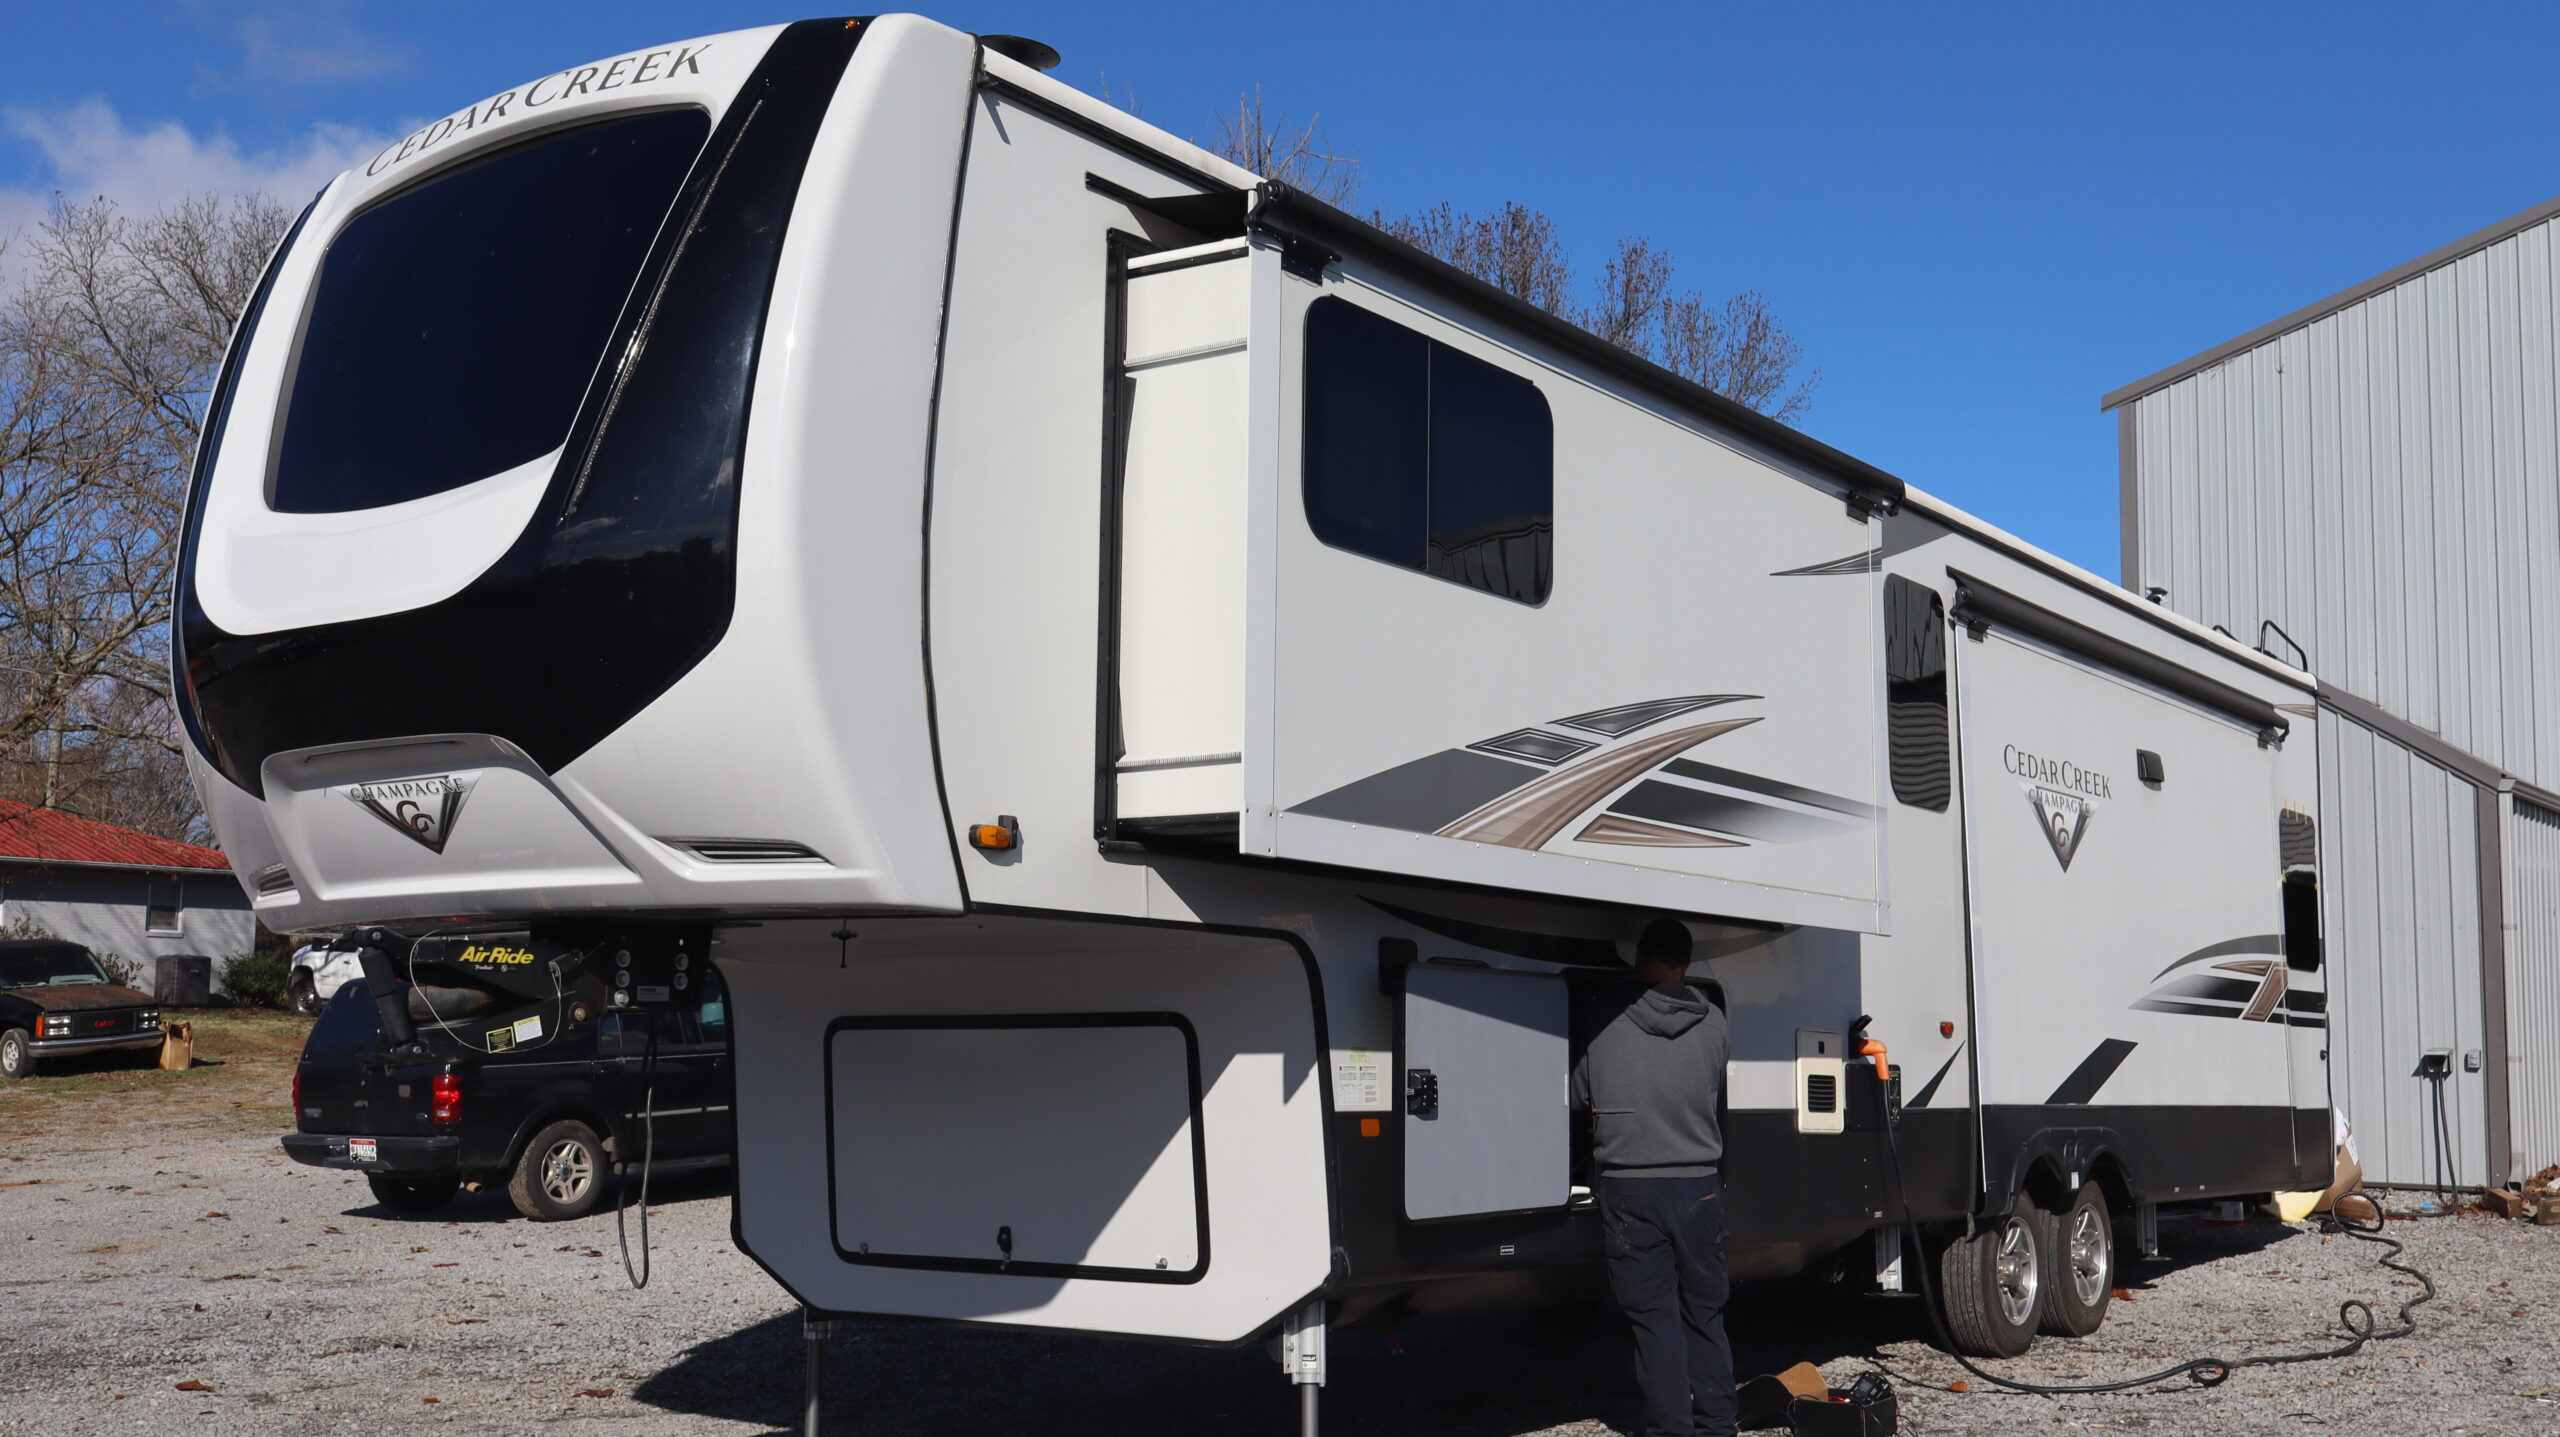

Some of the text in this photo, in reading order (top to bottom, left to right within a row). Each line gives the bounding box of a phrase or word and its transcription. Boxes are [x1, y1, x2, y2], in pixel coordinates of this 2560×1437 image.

[366, 43, 713, 177] CEDAR CREEK
[350, 777, 467, 802] CHAMPAGNE
[2003, 743, 2112, 800] CEDAR CREEK
[2028, 787, 2091, 815] CHAMPAGNE
